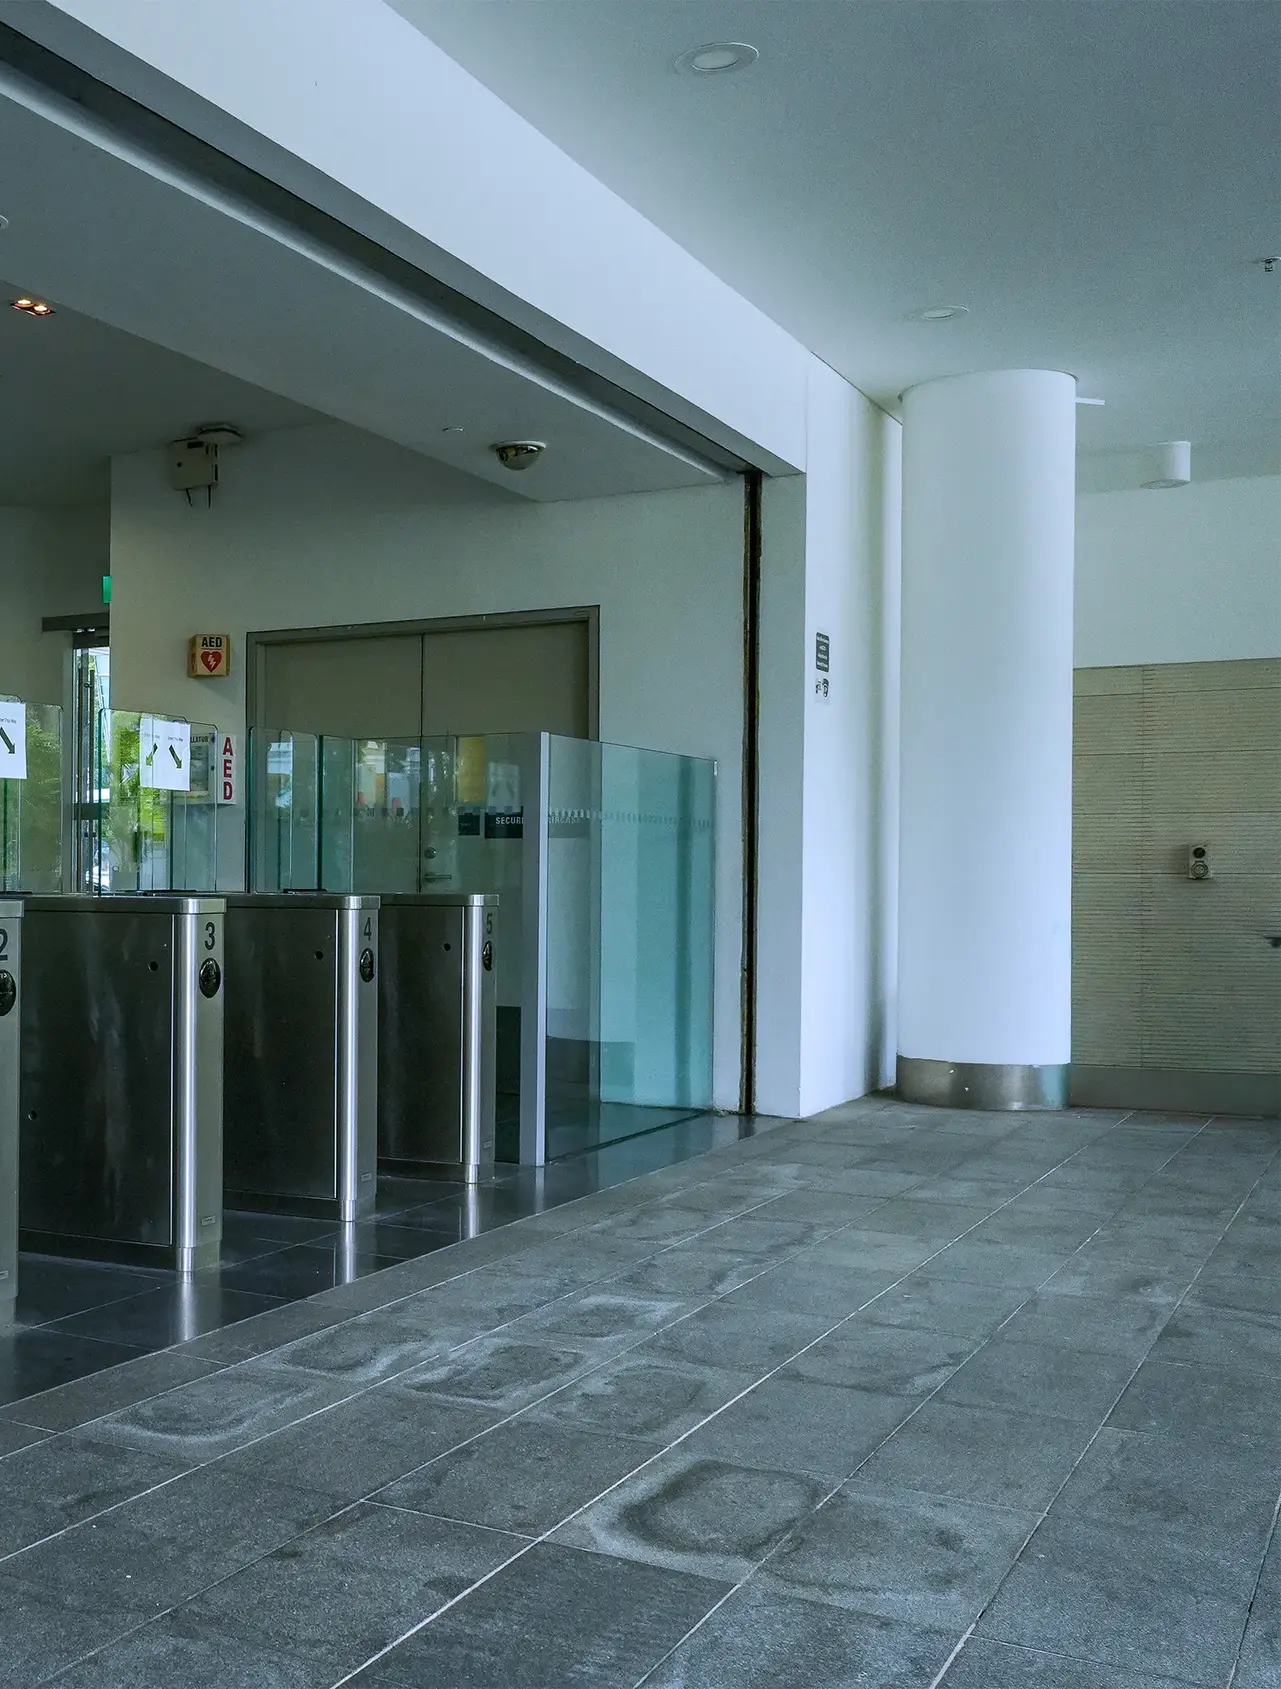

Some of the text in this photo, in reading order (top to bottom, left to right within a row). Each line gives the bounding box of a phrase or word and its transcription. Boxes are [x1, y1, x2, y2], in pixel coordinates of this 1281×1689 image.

[201, 636, 222, 648] AED
[223, 736, 233, 800] AED
[363, 917, 372, 941] 4
[486, 912, 493, 934] 5
[204, 921, 216, 951] 3
